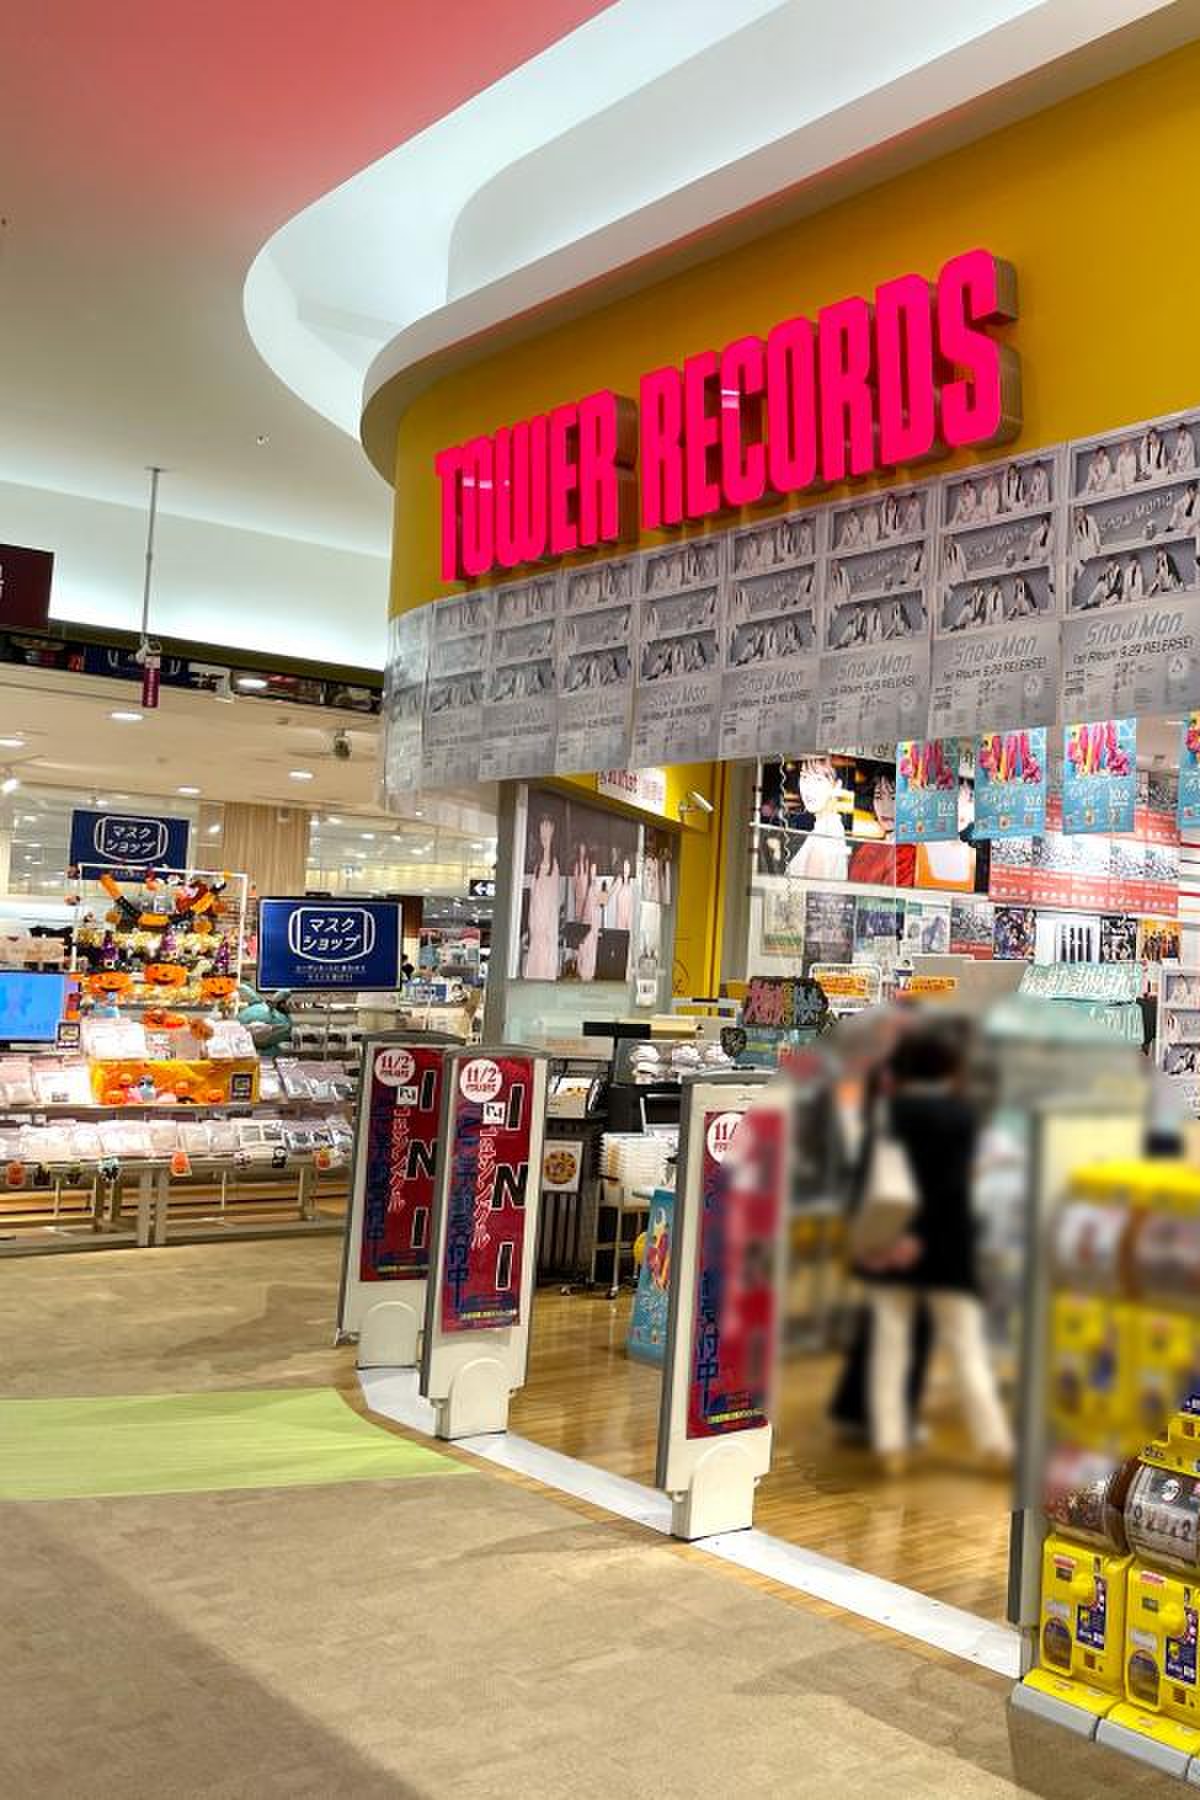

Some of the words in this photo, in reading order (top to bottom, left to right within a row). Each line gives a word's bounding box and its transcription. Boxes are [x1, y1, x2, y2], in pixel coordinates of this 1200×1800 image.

[436, 389, 622, 582] TOWER
[640, 248, 1006, 531] RECORDS
[112, 826, 151, 838] マスク
[105, 838, 157, 853] ショップ
[309, 917, 356, 933] マスク
[303, 934, 362, 952] ショップ
[380, 1055, 410, 1070] 11/2
[466, 1066, 497, 1084] 11/2
